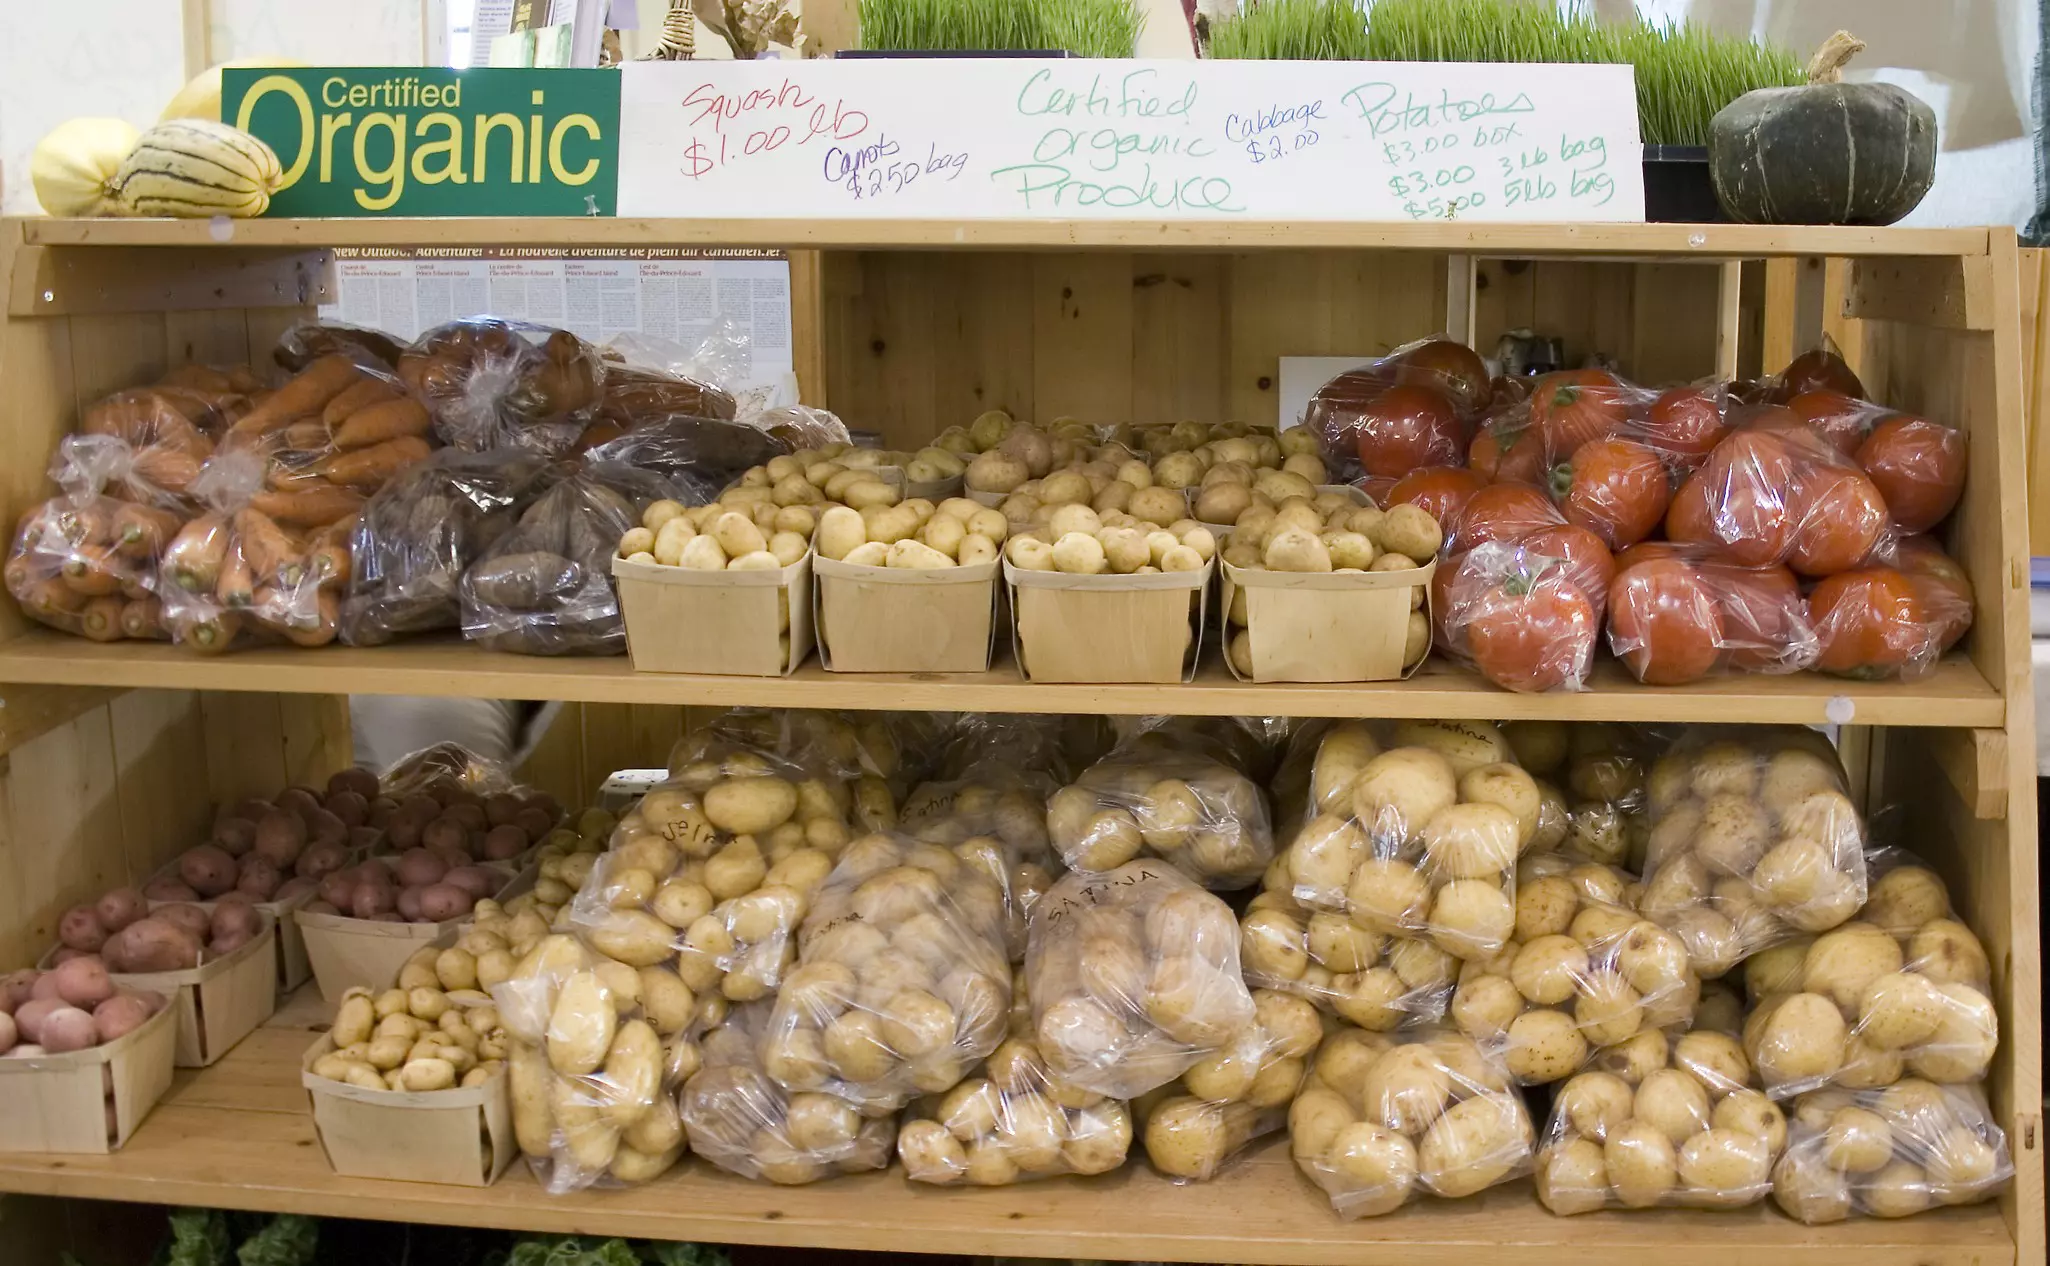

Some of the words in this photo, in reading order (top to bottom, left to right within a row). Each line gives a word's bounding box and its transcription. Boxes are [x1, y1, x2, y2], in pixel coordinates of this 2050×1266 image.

[322, 77, 461, 108] Certified
[682, 78, 815, 133] Squash
[1017, 68, 1198, 118] Certified
[1341, 82, 1535, 139] Potatoes
[237, 75, 602, 210] Organic
[681, 126, 790, 180] $1.00
[797, 99, 869, 144] lb
[1226, 99, 1328, 142] Cabbage
[1382, 133, 1459, 168] $3.00
[1473, 122, 1522, 148] box
[925, 141, 969, 181] bag
[1246, 130, 1319, 163] $2.00
[1388, 165, 1475, 199] $3.00
[1497, 156, 1514, 178] 3
[1560, 132, 1607, 173] bag
[990, 162, 1246, 212] Produce
[1403, 192, 1486, 220] $500
[1570, 167, 1615, 208] bag
[571, 247, 628, 257] aventure
